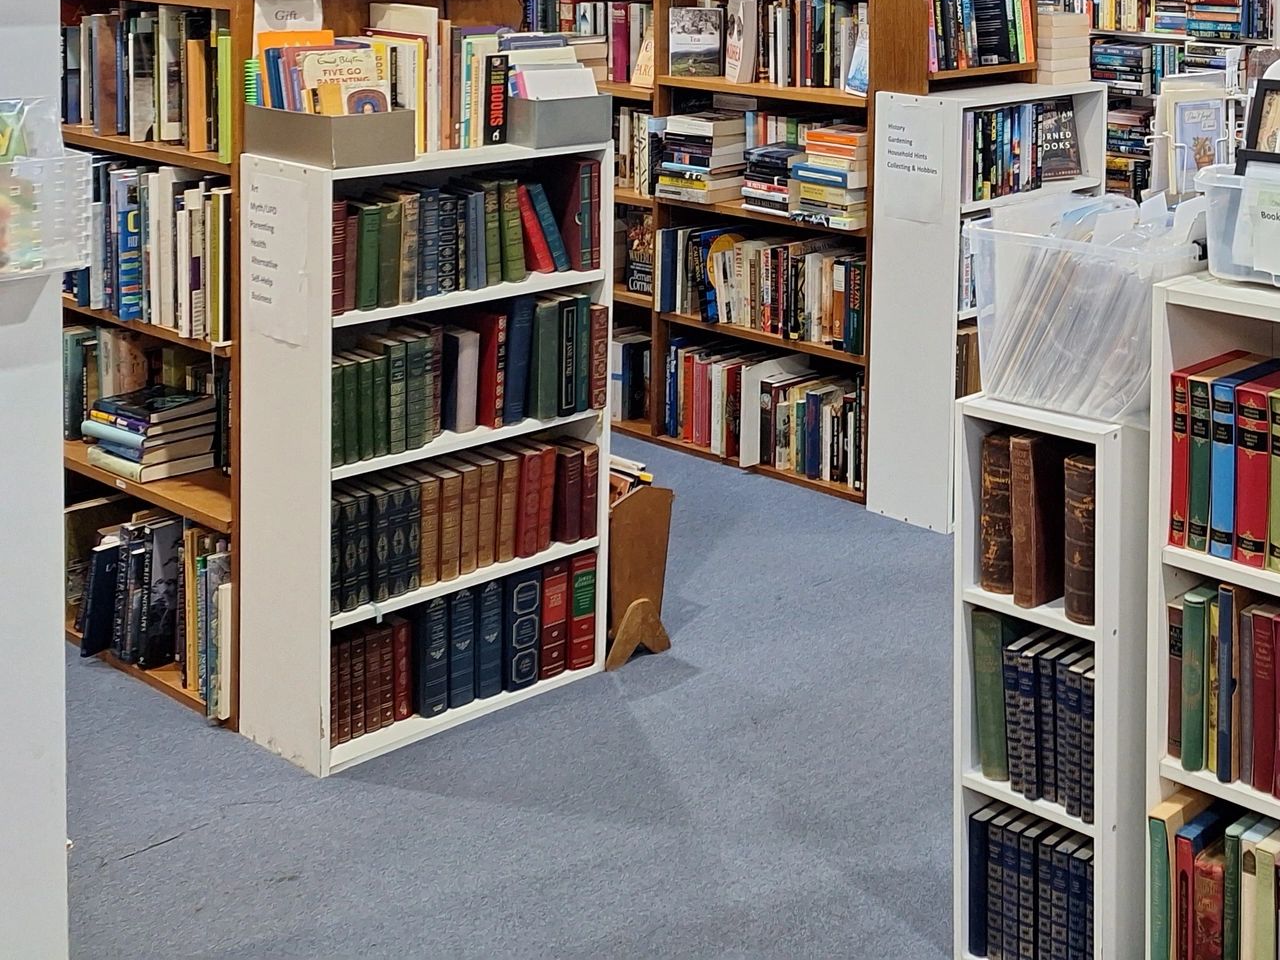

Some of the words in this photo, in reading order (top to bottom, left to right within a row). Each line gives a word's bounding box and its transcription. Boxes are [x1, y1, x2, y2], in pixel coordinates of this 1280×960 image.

[275, 10, 298, 21] Gift
[935, 2, 943, 36] Interpreter
[323, 68, 344, 76] FIVE
[347, 67, 361, 75] GO
[491, 85, 504, 126] BOOKS
[888, 124, 905, 132] History
[888, 136, 912, 146] Gardening
[1042, 131, 1072, 142] URNED
[1261, 211, 1280, 221] Book
